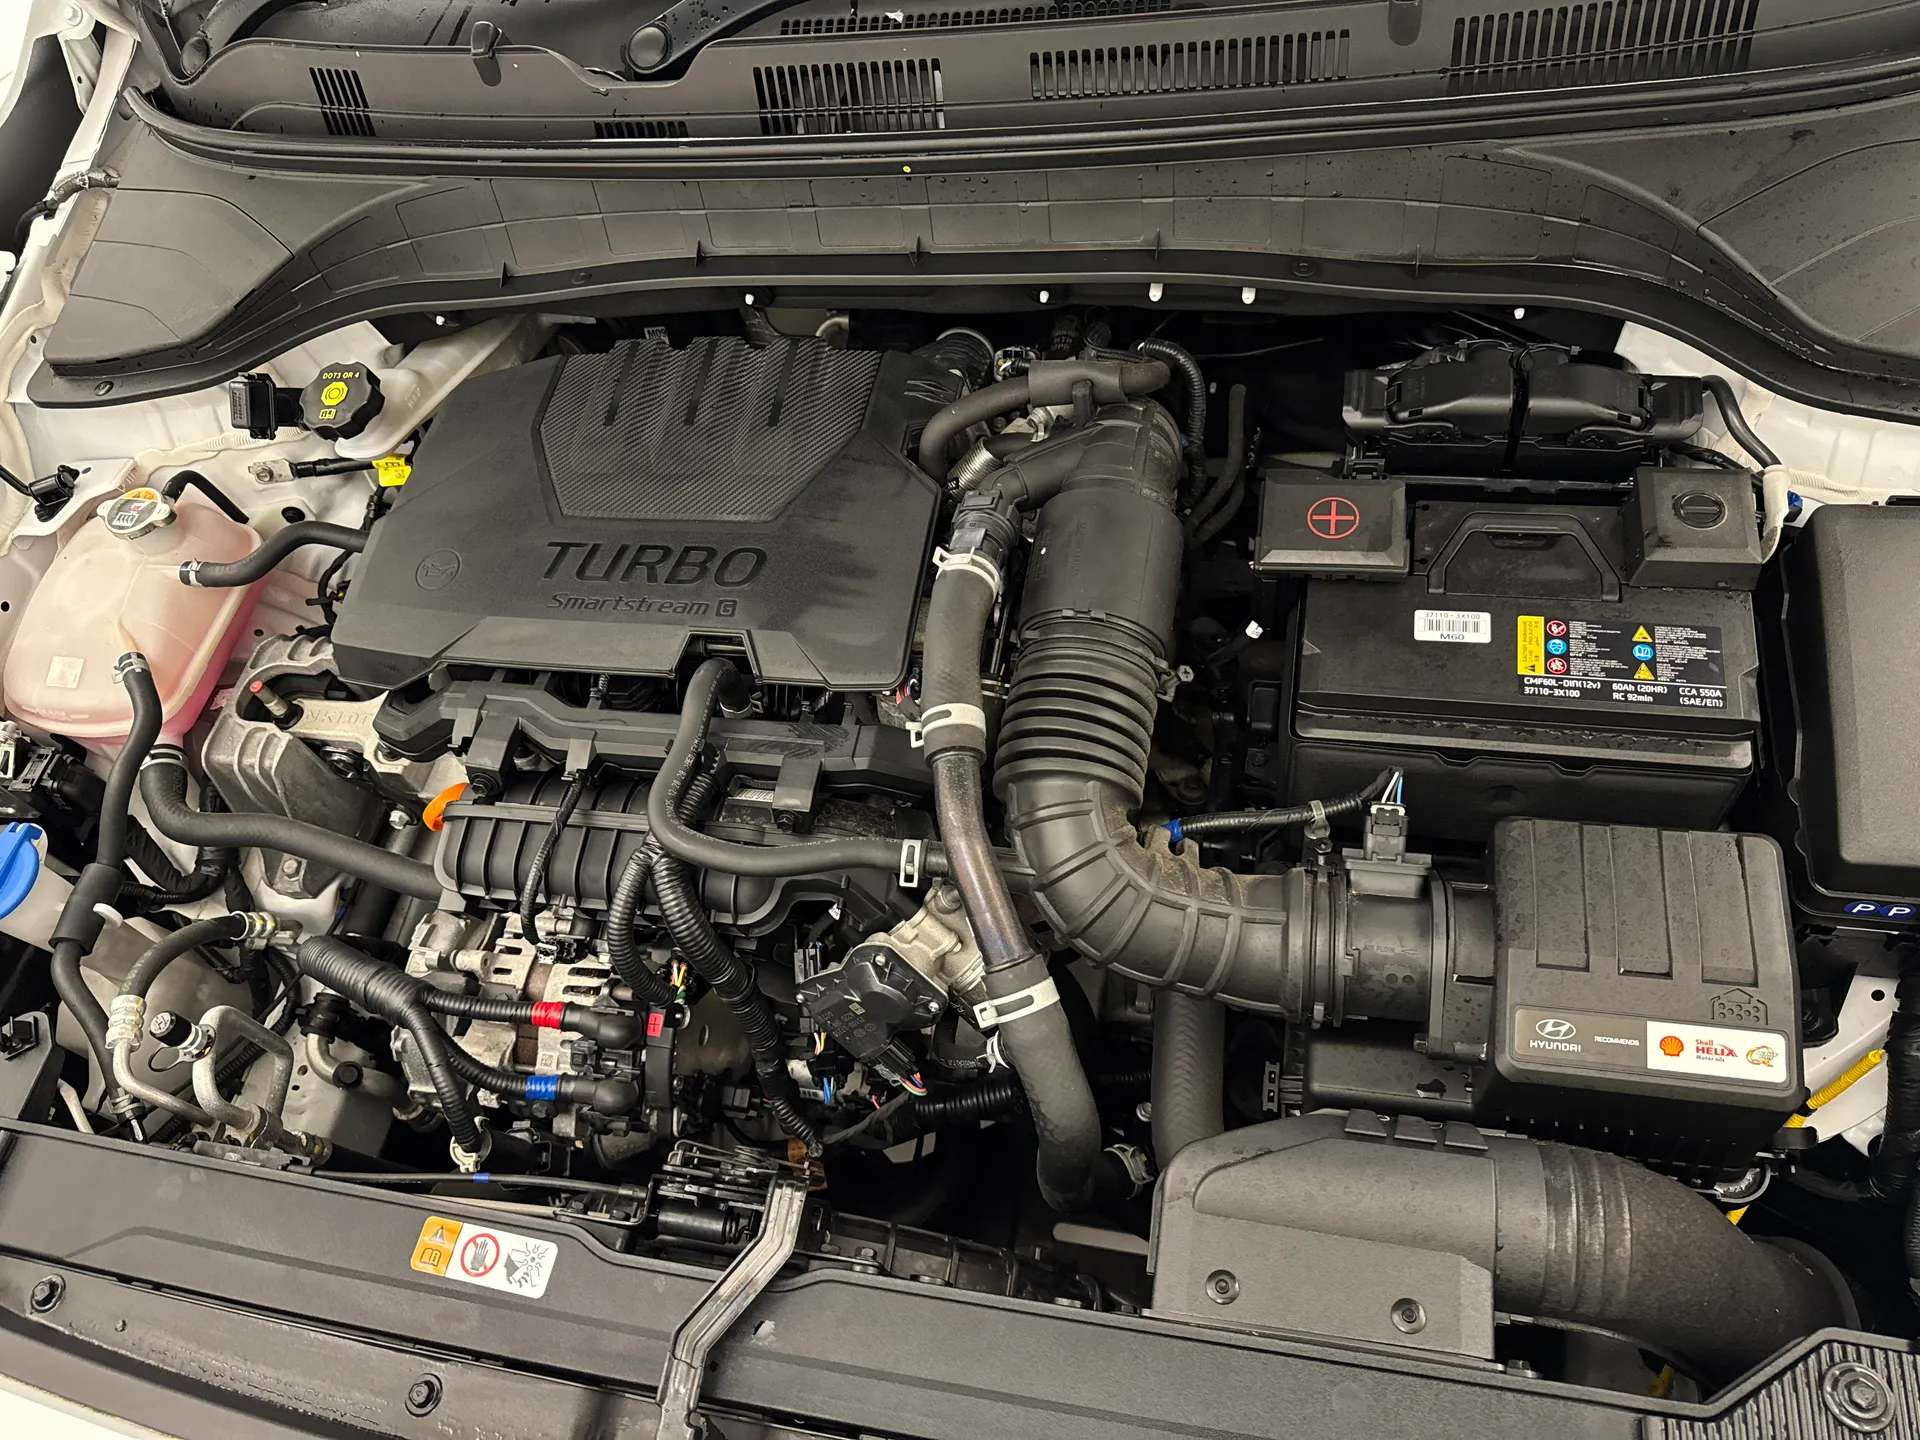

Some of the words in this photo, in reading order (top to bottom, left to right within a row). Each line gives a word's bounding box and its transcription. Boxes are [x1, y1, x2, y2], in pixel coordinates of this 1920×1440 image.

[543, 541, 768, 588] TURBO
[547, 592, 710, 616] Smartstream
[717, 600, 736, 616] G
[1523, 686, 1581, 698] 37110-3X100
[1612, 683, 1635, 692] 60Ah
[1637, 684, 1668, 694] (20HR)
[1679, 687, 1697, 696] CCA
[1699, 688, 1723, 698] 550A
[1612, 692, 1626, 700] RC
[1627, 693, 1654, 702] 92min
[1851, 903, 1876, 913] P
[1887, 906, 1911, 917] P
[1529, 1039, 1582, 1053] HYUNDAI
[1695, 1046, 1736, 1058] HELIX
